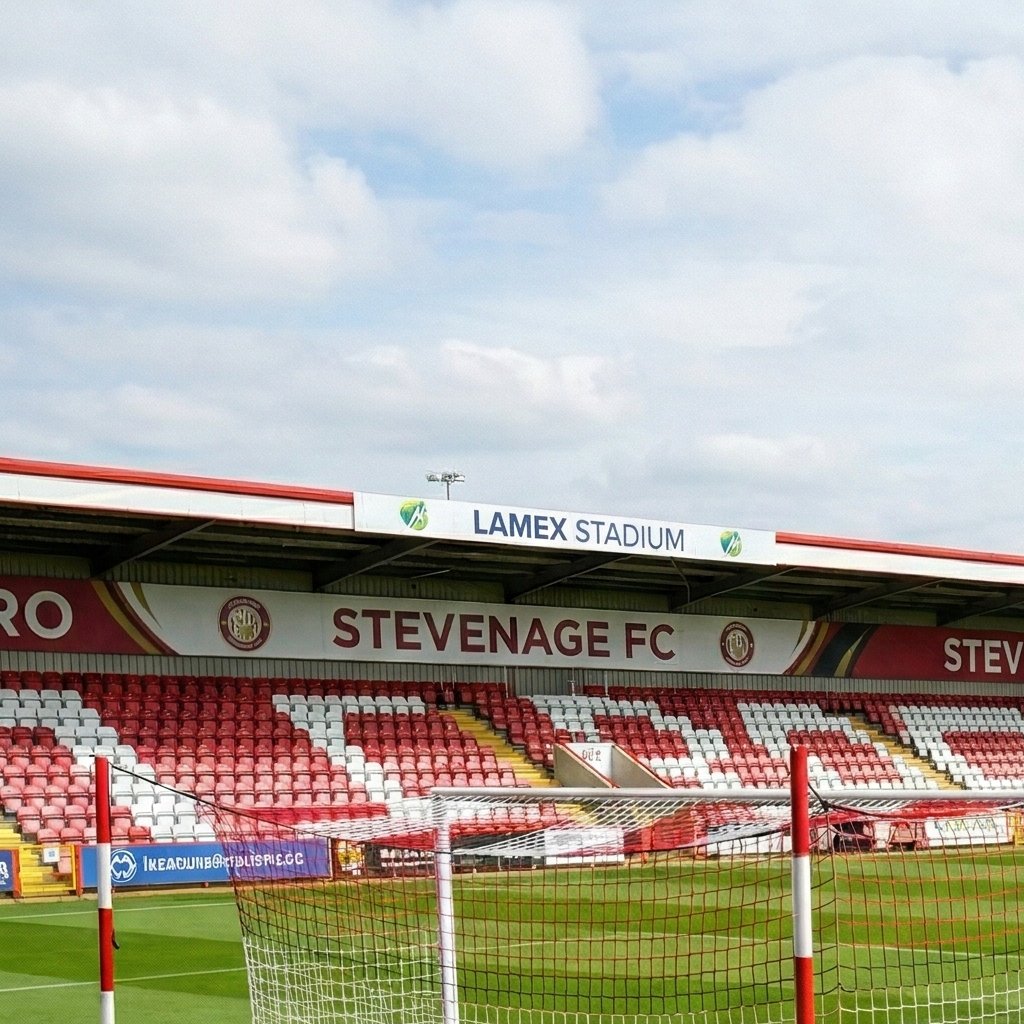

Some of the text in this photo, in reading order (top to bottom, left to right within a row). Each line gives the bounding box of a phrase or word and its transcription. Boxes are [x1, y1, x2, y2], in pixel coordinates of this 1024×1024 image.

[473, 509, 685, 551] LAMEX STADIUM
[332, 607, 676, 661] STEVENAGE FC
